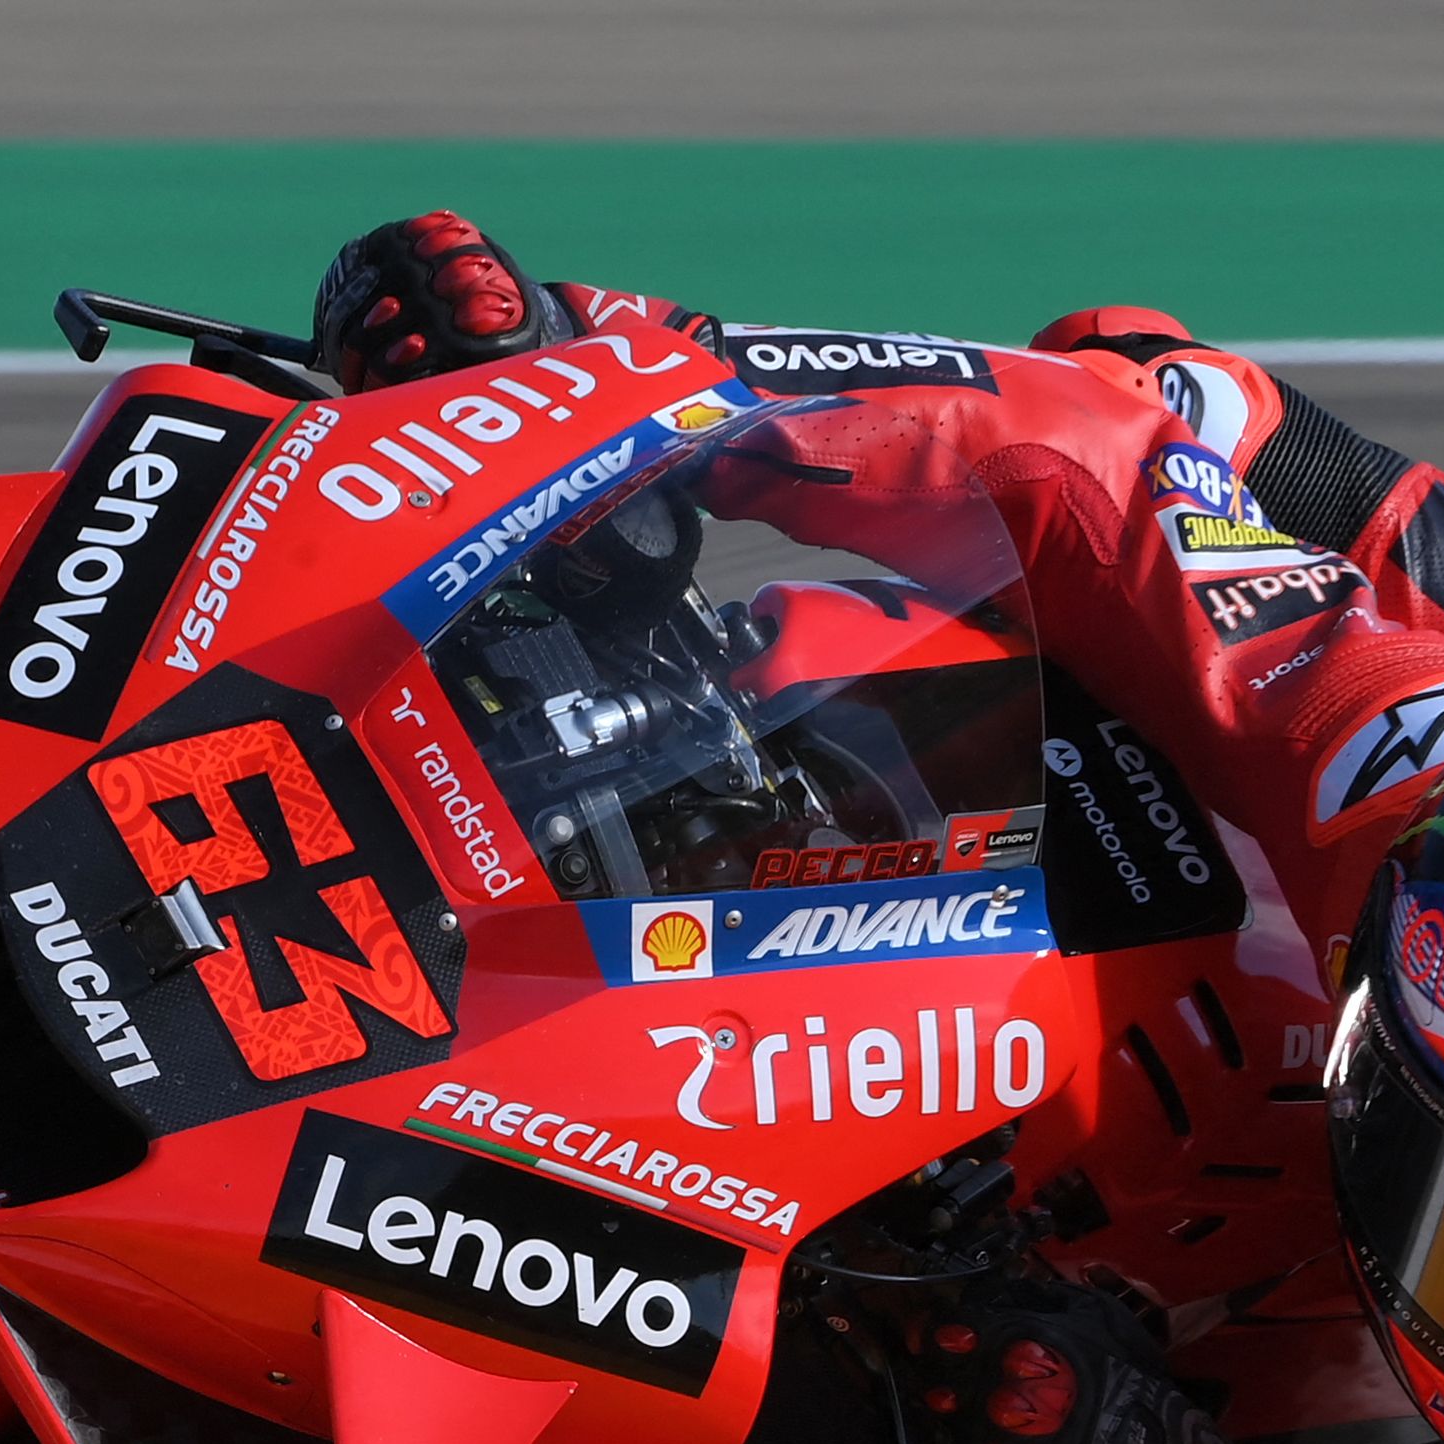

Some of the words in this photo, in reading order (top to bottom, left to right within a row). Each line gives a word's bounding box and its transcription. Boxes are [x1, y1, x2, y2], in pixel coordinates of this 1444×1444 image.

[318, 356, 597, 521] riello
[746, 342, 975, 379] Lenovo
[9, 414, 227, 698] Lenovo
[164, 405, 340, 673] FRECCIAROSSA
[427, 436, 636, 602] ADVANCE
[1207, 560, 1362, 631] ruba.it
[414, 741, 525, 901] randstad
[751, 839, 938, 891] PECCO
[988, 832, 1034, 847] Lenovo
[1069, 780, 1152, 905] motorola
[1095, 717, 1213, 887] Lenovo
[87, 718, 452, 1083] 63
[745, 887, 1025, 961] ADVANCE
[9, 881, 161, 1089] DUCATI
[750, 1007, 1047, 1126] riello
[417, 1081, 801, 1238] FRECCIAROSSA
[303, 1153, 692, 1349] Lenovo
